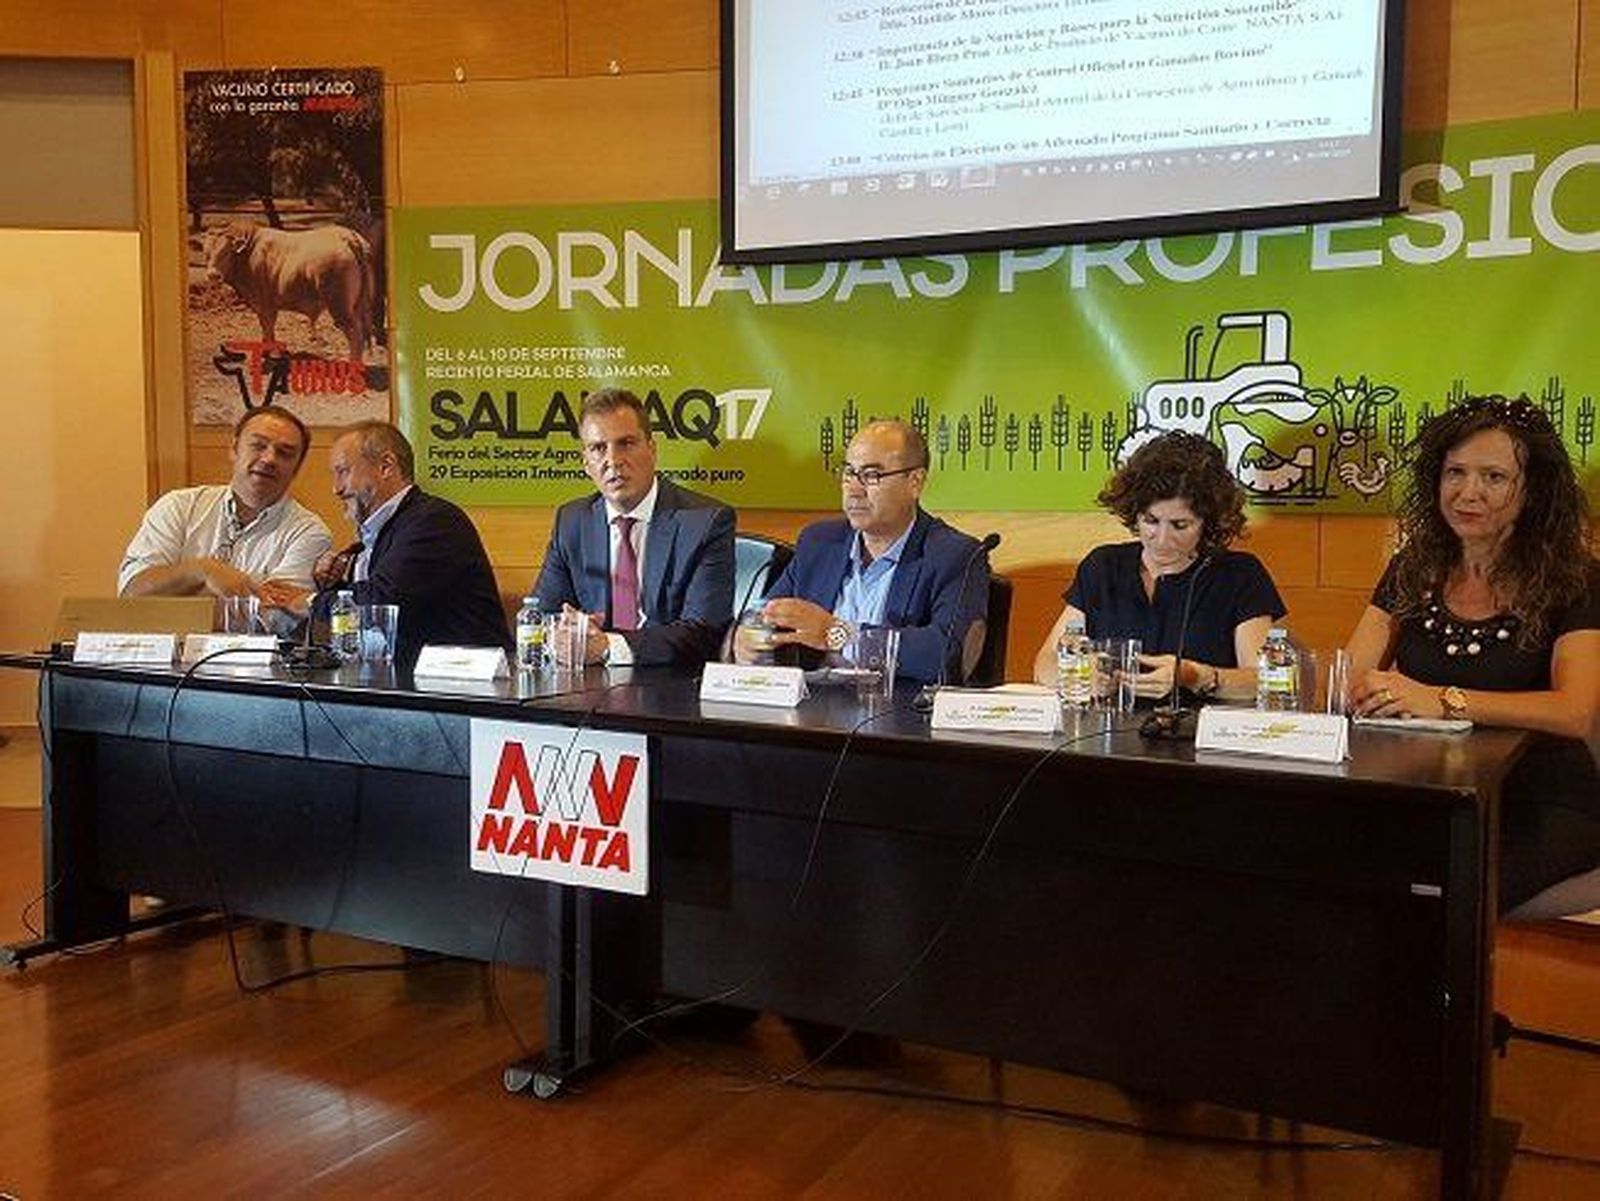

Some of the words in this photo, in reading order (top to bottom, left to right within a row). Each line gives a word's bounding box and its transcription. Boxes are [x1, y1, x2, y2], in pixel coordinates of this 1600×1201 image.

[1060, 22, 1096, 36] Bases
[1099, 18, 1131, 33] para
[1136, 13, 1148, 25] la
[1245, 14, 1304, 31] NANTA
[1025, 61, 1077, 78] Control
[1080, 58, 1125, 74] Oficial
[210, 83, 268, 97] VACUNO
[271, 80, 356, 96] CERTIFICADO
[210, 101, 231, 113] con
[418, 227, 970, 312] JORNADAS
[426, 348, 453, 361] DEL
[456, 350, 466, 361] 6
[468, 349, 489, 361] AL
[491, 348, 508, 361] 10
[509, 348, 530, 361] DE
[531, 347, 626, 361] SEPTIEMBRE
[426, 366, 494, 379] RECINTO
[497, 366, 551, 379] FERIAL
[553, 365, 575, 378] DE
[576, 364, 671, 379] SALAMANCA
[430, 388, 773, 449] SALAAQ17
[429, 445, 466, 460] Feria
[467, 444, 490, 460] del
[493, 445, 541, 460] Sector
[430, 465, 448, 479] 29
[531, 465, 592, 480] Interna
[709, 468, 745, 484] puro
[477, 813, 631, 873] NANTA
